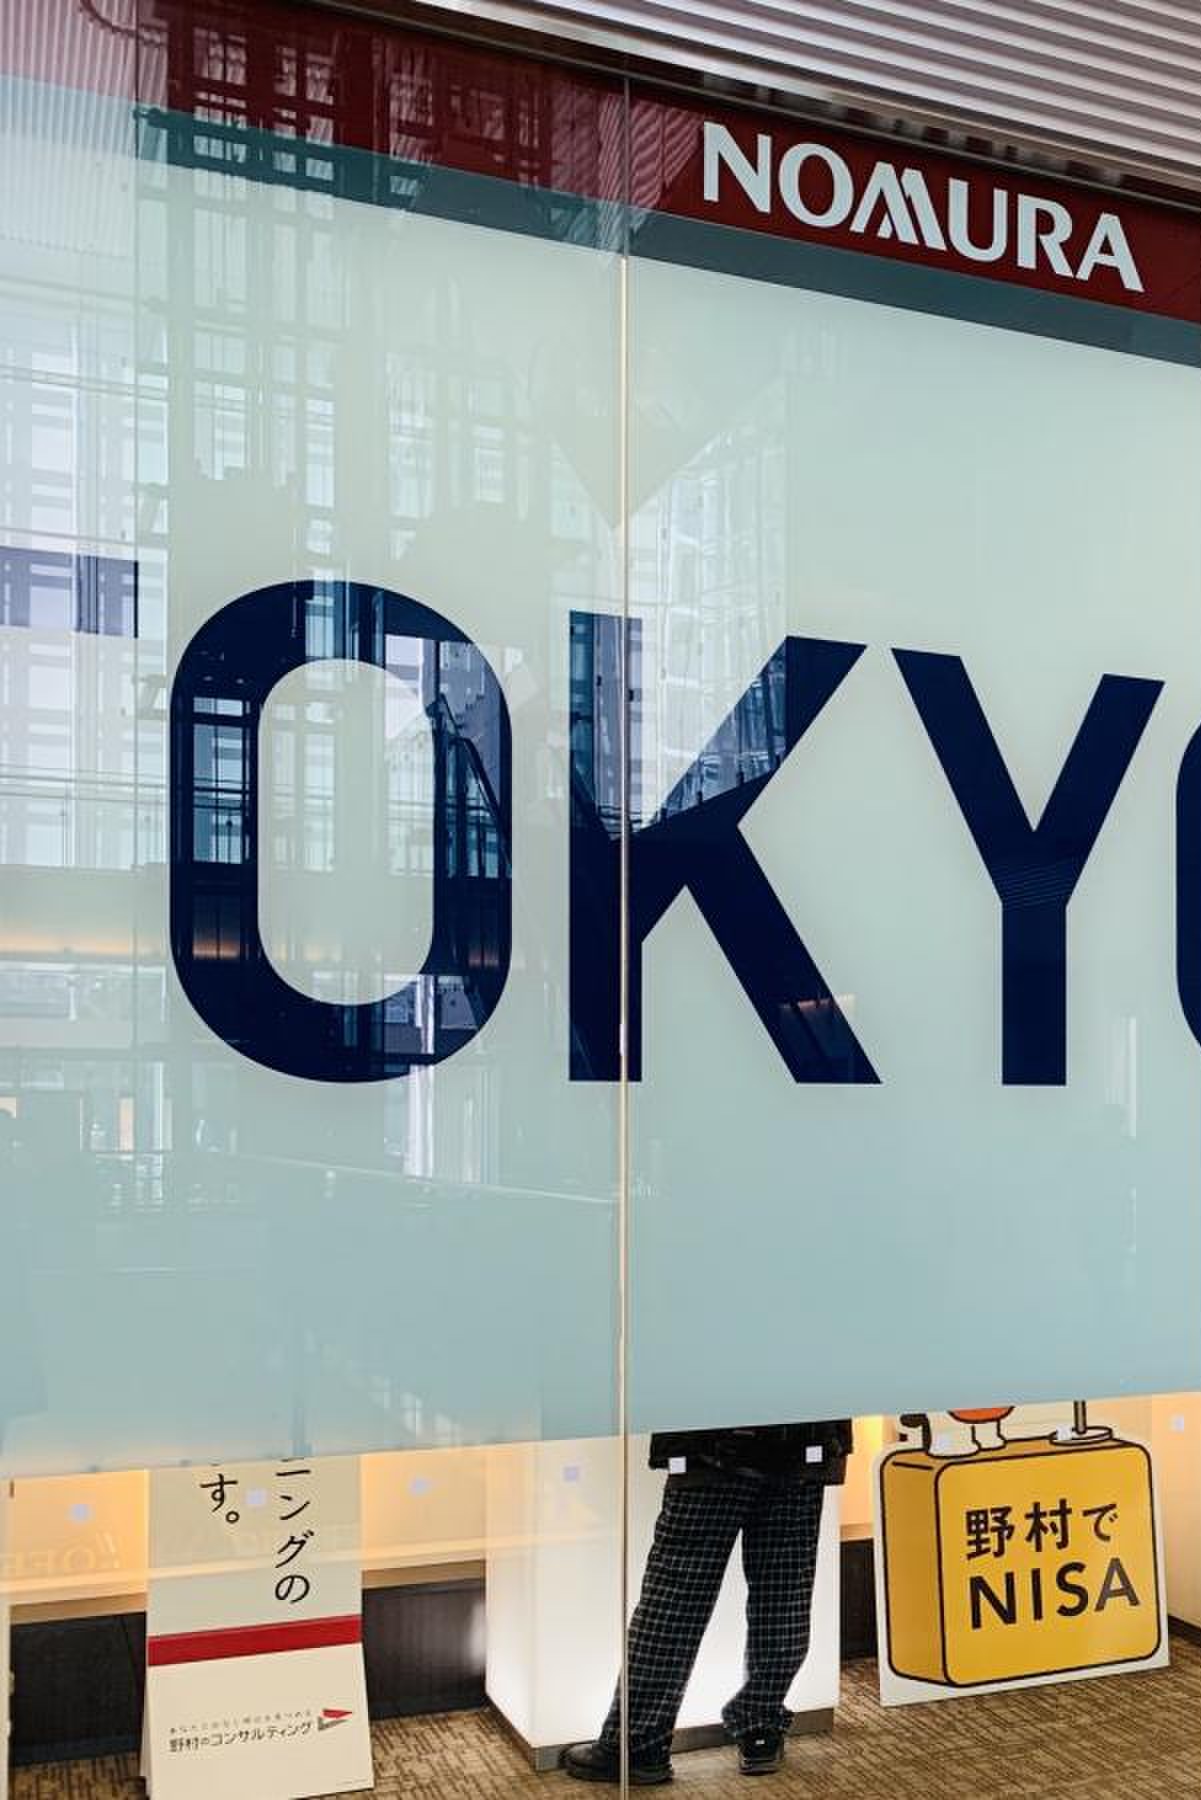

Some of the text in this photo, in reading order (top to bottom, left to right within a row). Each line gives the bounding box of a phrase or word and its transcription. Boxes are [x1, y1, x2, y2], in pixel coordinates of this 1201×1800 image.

[702, 121, 1145, 293] NOMURA
[199, 1462, 240, 1524] す。
[965, 1498, 1119, 1561] 野村で
[968, 1557, 1141, 1629] NISA
[168, 1718, 313, 1753] 野村のコンサルティング
